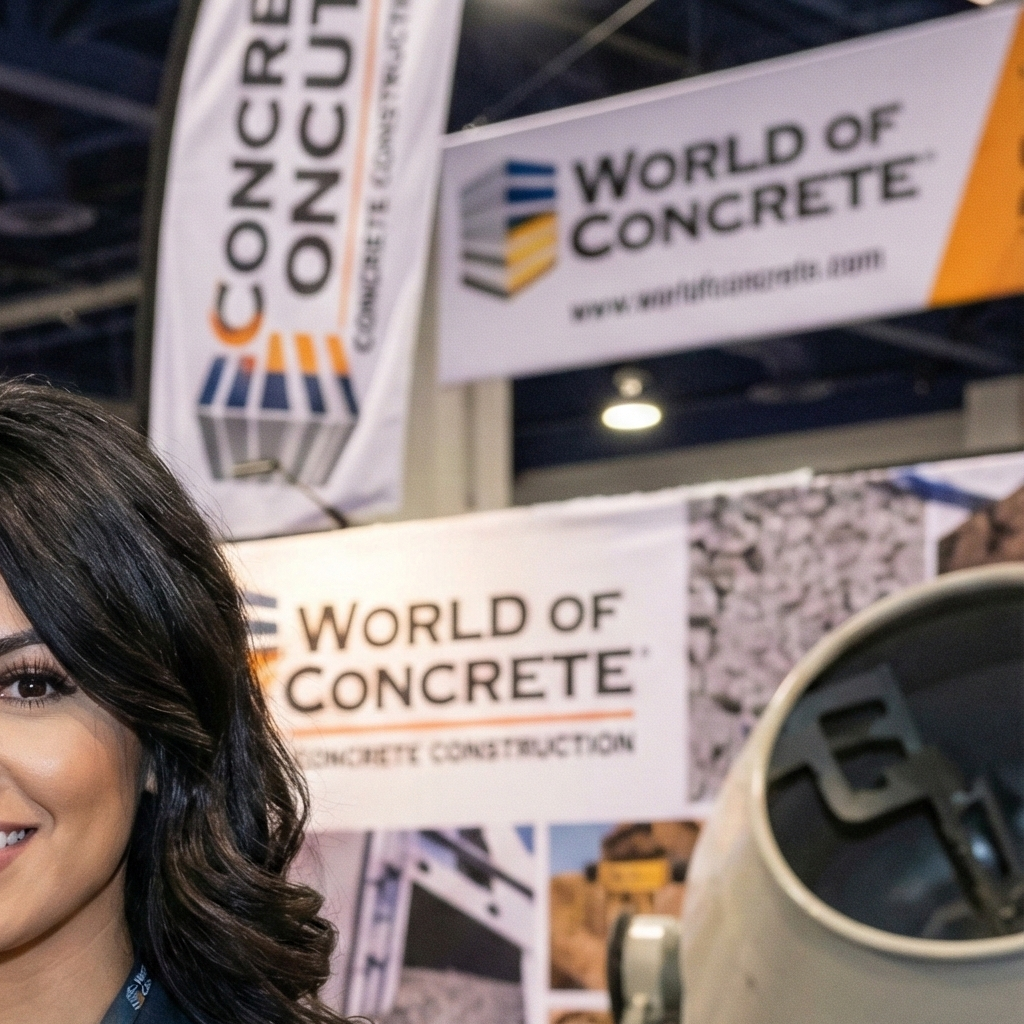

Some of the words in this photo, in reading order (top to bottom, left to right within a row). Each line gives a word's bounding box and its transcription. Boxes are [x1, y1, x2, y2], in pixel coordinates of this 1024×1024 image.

[574, 122, 807, 206] WORLD
[825, 101, 902, 154] OF
[572, 155, 919, 261] CONCRETE
[299, 594, 529, 653] WORLD
[551, 591, 622, 634] OF
[286, 648, 633, 713] CONCRETE
[431, 731, 636, 764] CONSTRUCTION
